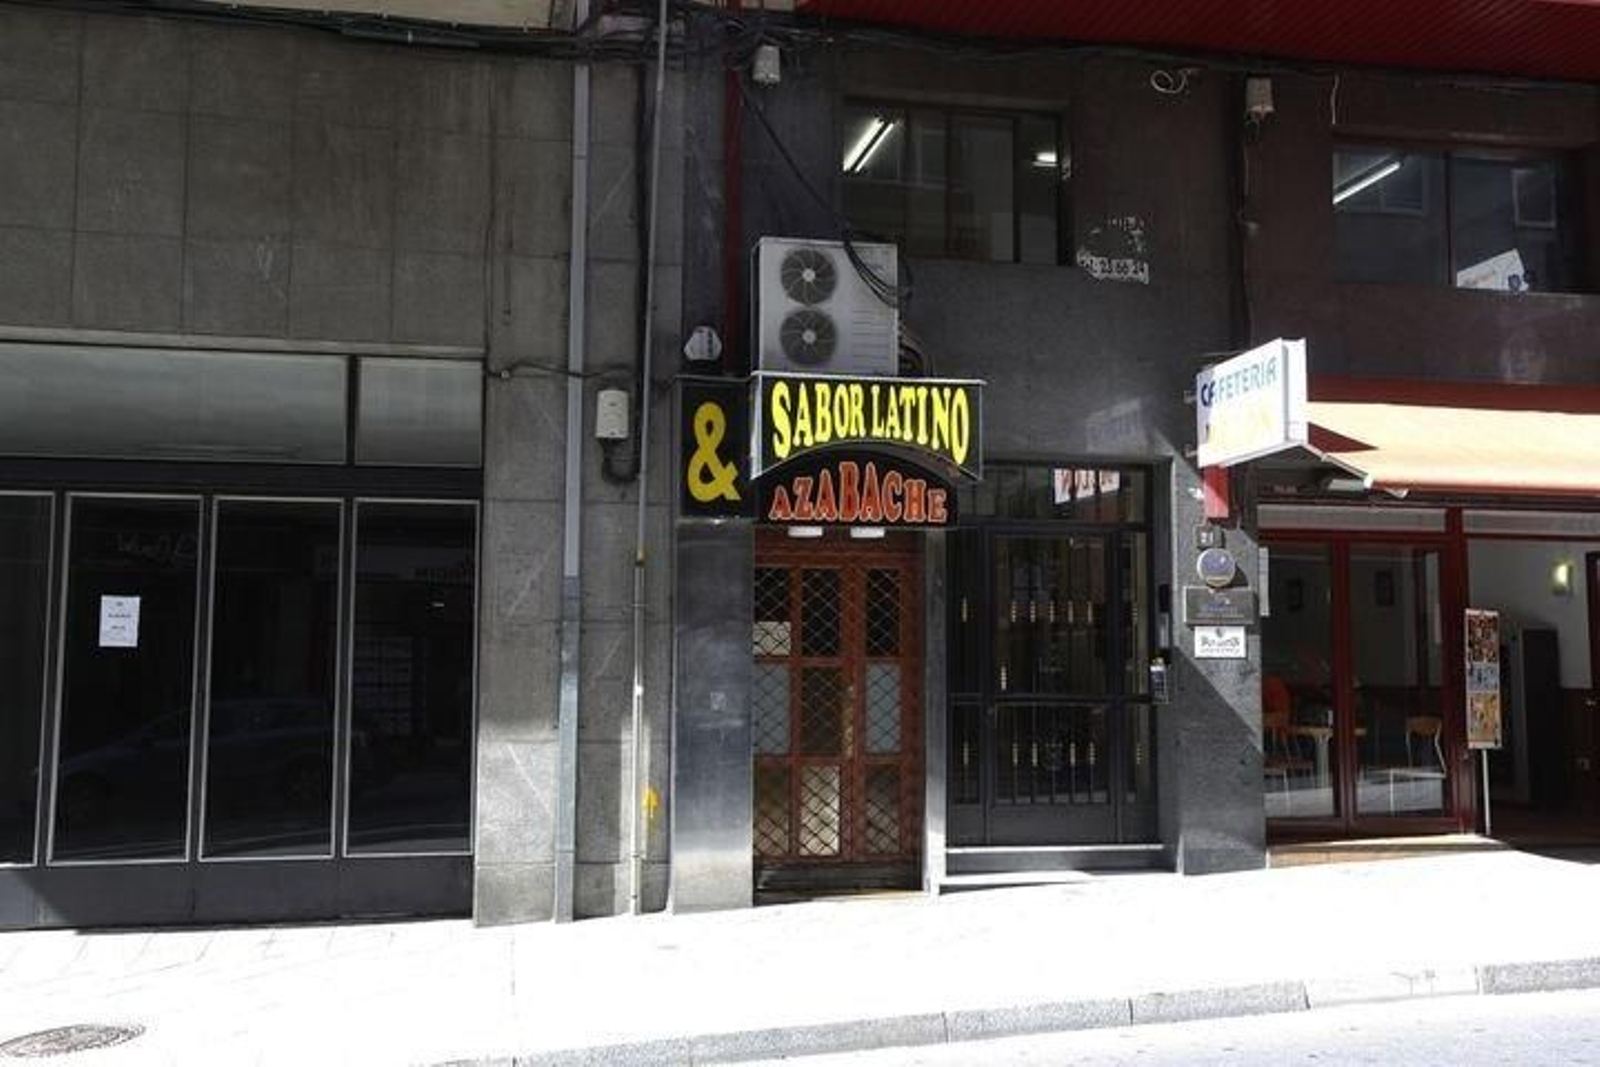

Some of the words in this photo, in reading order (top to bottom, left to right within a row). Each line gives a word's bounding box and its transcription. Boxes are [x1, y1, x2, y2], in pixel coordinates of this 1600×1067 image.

[687, 400, 742, 503] &
[771, 379, 867, 459] SABOR
[870, 383, 970, 466] LATINO
[768, 460, 948, 523] AZABACHE
